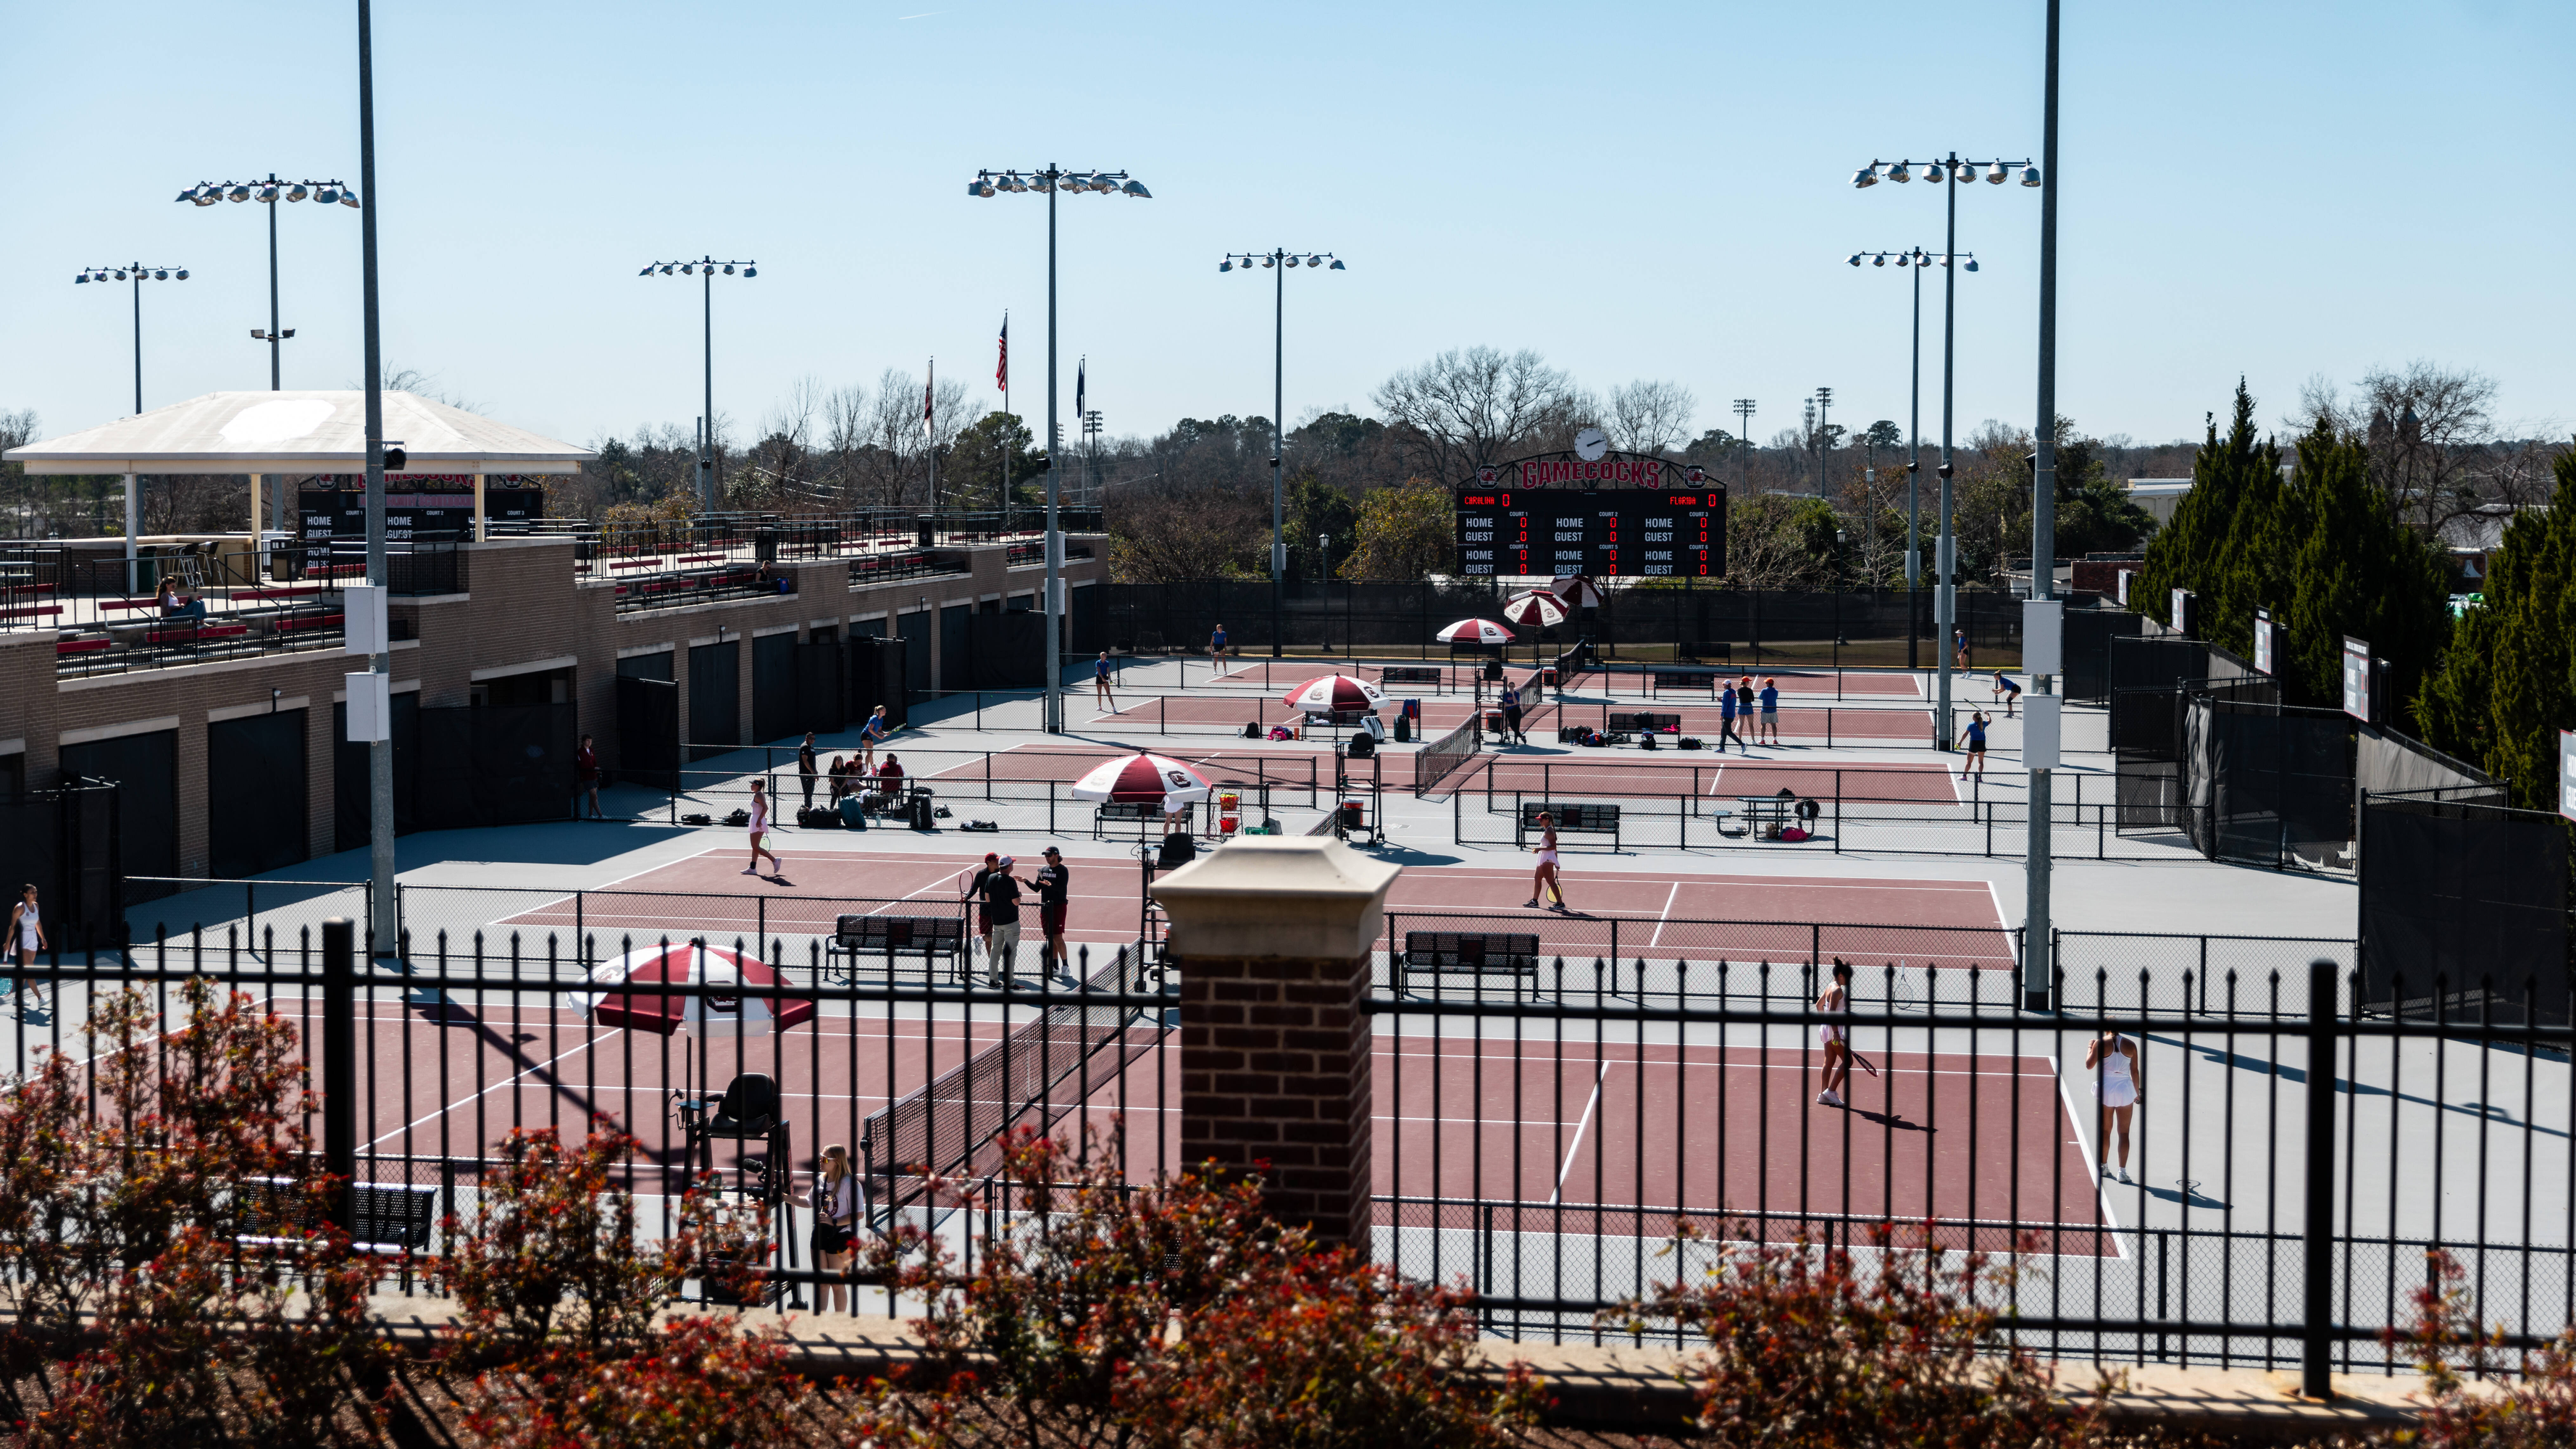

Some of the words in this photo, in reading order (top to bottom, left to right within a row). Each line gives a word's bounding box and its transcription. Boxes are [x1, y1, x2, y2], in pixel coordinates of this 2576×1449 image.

[1522, 461, 1660, 490] GAMECOCKS
[386, 495, 417, 506] FAMILY
[418, 495, 475, 506] SCOREBOAR
[1464, 496, 1494, 505] CAROLINA
[1502, 494, 1510, 506] 0
[1670, 496, 1696, 505] FLORIDA
[1708, 494, 1715, 506] 0
[307, 516, 332, 525] HOME
[387, 517, 412, 525] HOME
[1466, 518, 1493, 527] HOME
[1520, 517, 1527, 528] 0
[1556, 518, 1584, 527] HOME
[1610, 517, 1616, 528] 0
[1645, 518, 1673, 527] HOME
[1700, 517, 1707, 528] 0
[1465, 532, 1494, 541] GUEST
[1520, 531, 1527, 542] 0
[1555, 532, 1583, 541] GUEST
[1610, 531, 1616, 542] 0
[1644, 532, 1673, 541] GUEST
[1700, 531, 1707, 542] 0
[1466, 551, 1493, 560] HOME
[1520, 550, 1527, 561] 0
[1555, 551, 1583, 560] HOME
[1610, 550, 1616, 561] 0
[1645, 551, 1673, 560] HOME
[1700, 550, 1707, 561] 0
[1465, 564, 1494, 574] GUEST
[1520, 564, 1527, 575] 0
[1555, 564, 1583, 574] GUEST
[1610, 564, 1616, 575] 0
[1644, 564, 1673, 574] GUEST
[1700, 564, 1707, 575] 0
